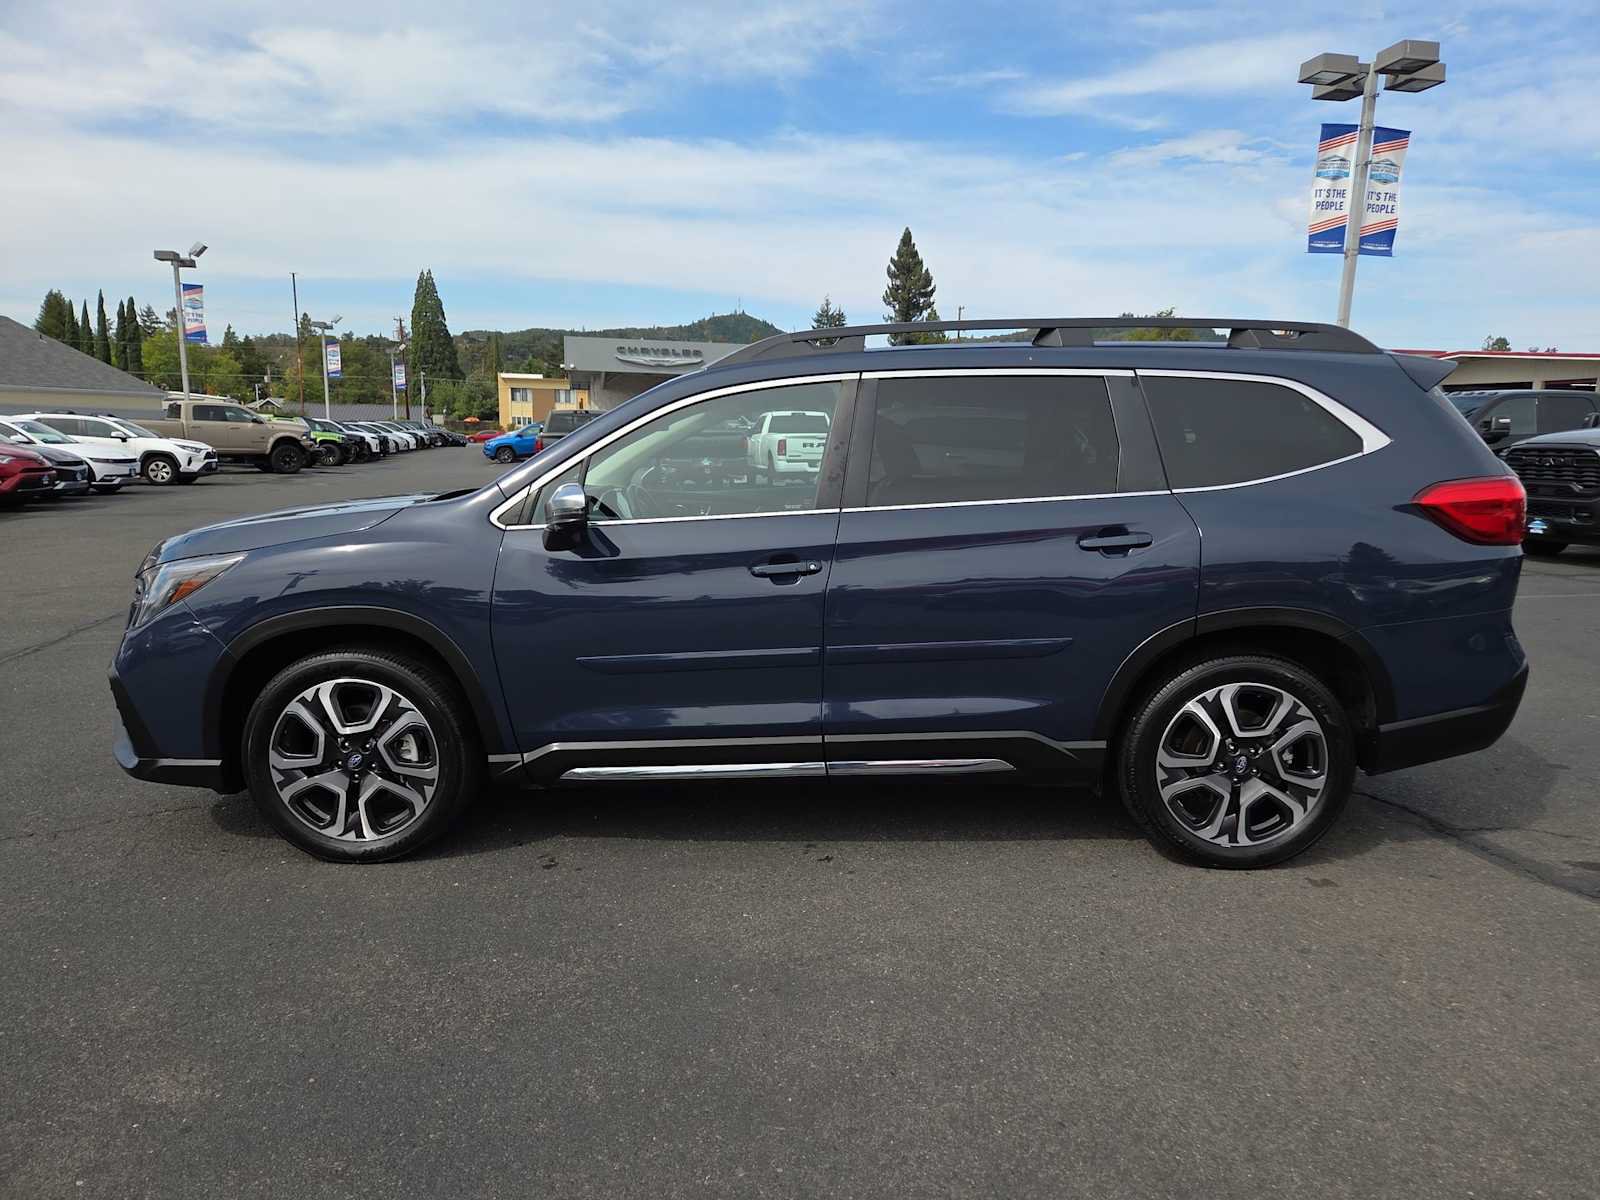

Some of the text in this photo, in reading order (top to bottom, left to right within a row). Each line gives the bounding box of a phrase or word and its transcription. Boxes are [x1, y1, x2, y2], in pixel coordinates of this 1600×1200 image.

[1314, 188, 1347, 199] IT'S THE
[1367, 190, 1397, 202] IT'S THE
[1315, 200, 1344, 211] PEOPLE
[1366, 203, 1396, 214] PEOPLE
[616, 346, 703, 358] CHRYSLER
